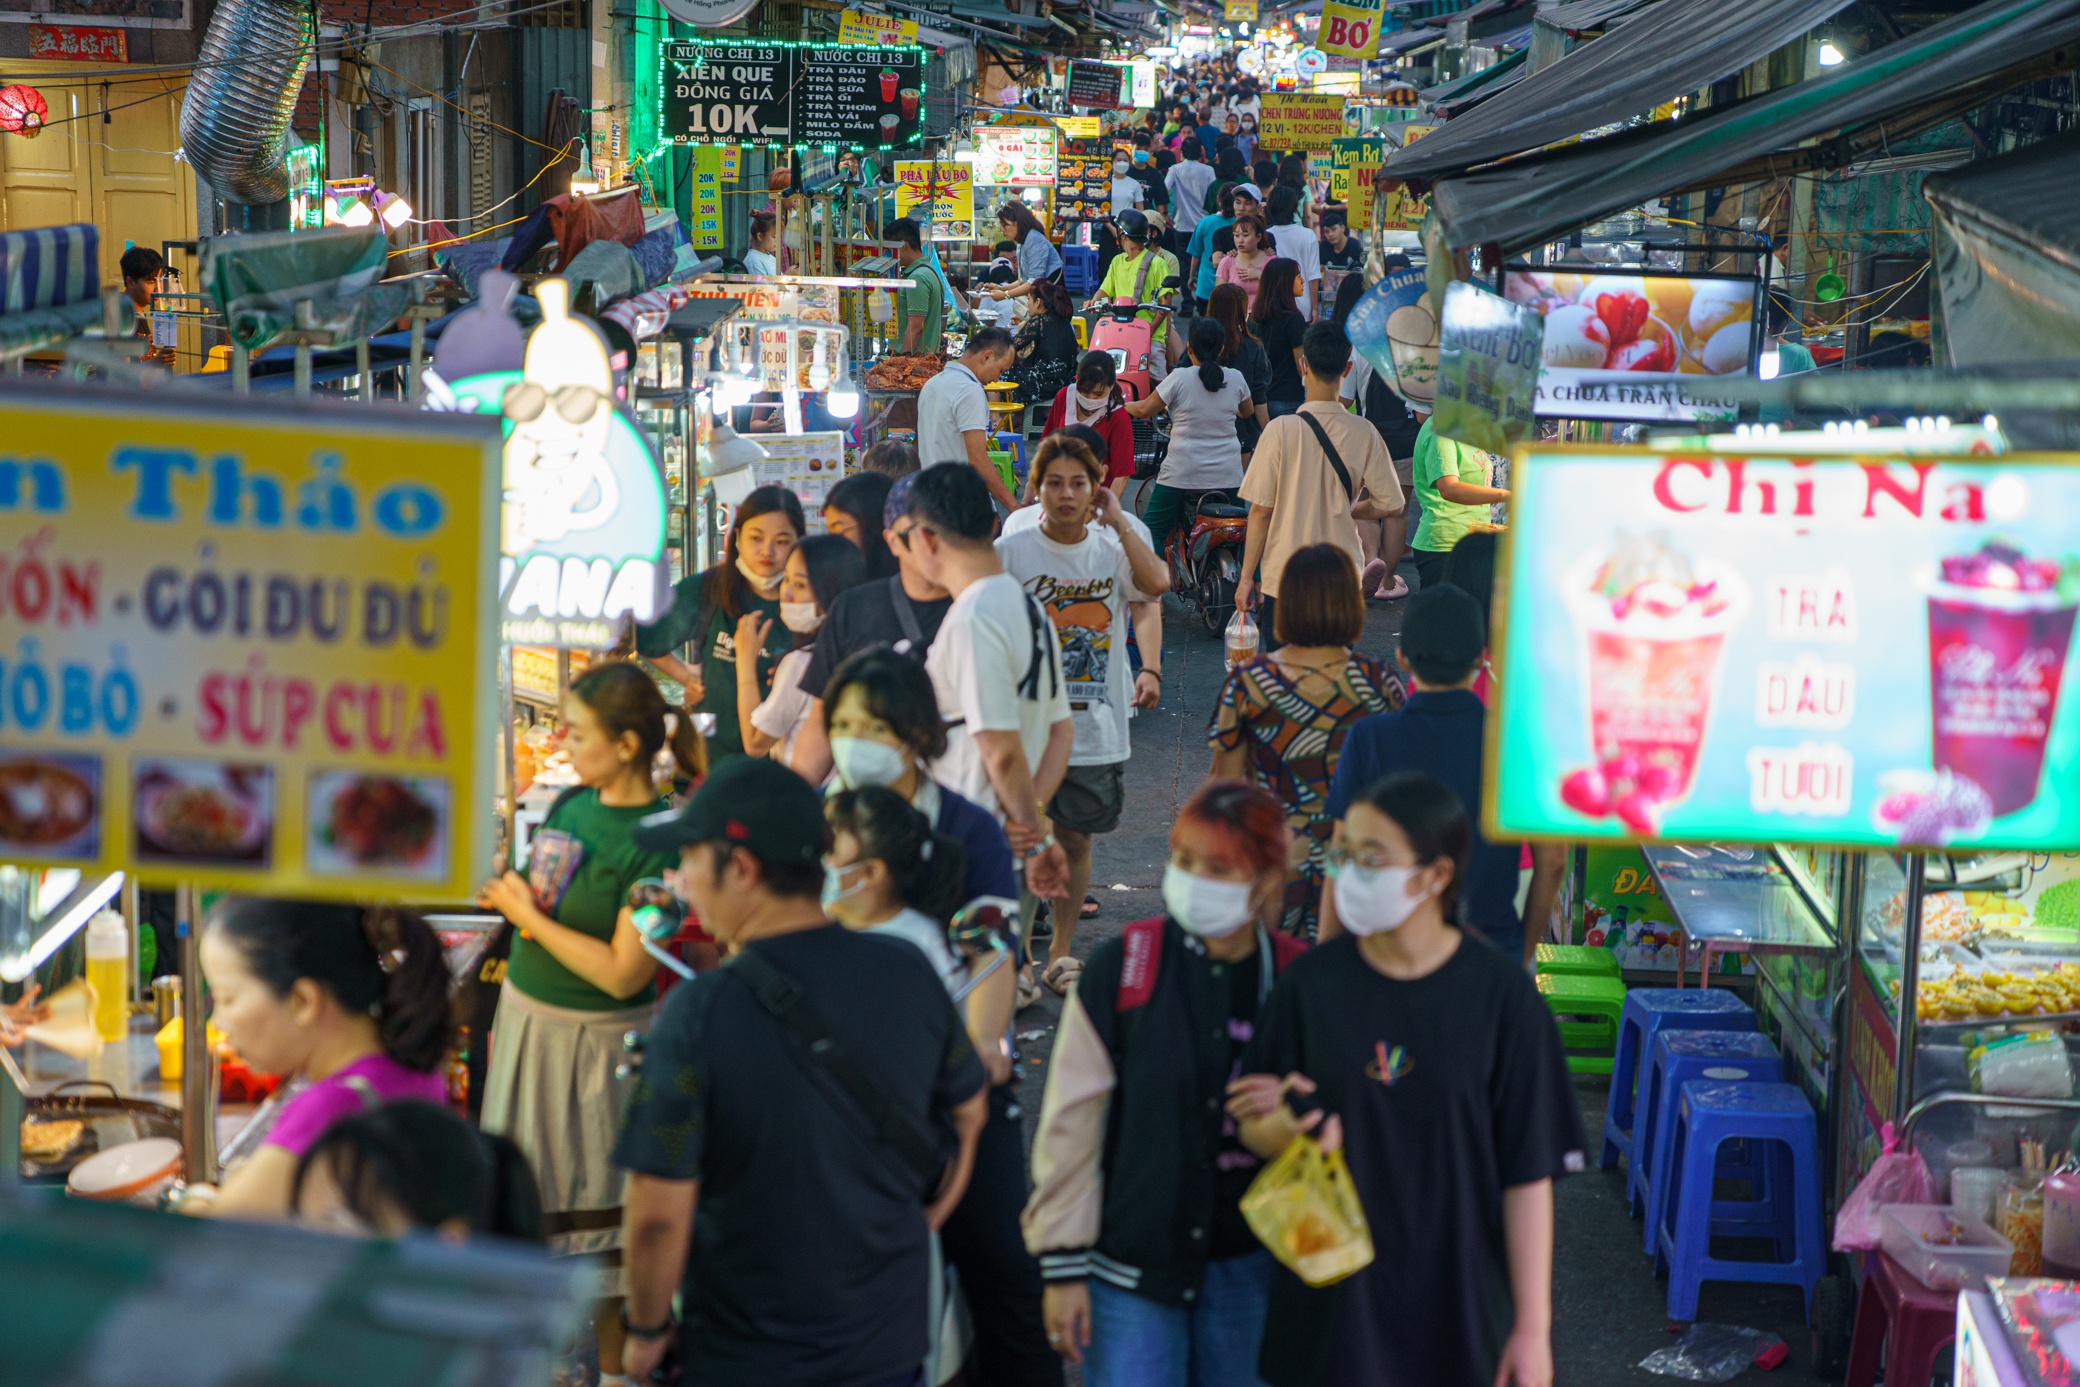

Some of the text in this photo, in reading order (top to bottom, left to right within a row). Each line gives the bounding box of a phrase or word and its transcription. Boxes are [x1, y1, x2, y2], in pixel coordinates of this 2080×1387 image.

[854, 15, 902, 31] JULIE
[1326, 15, 1373, 49] BƠ
[676, 45, 774, 62] NƯỚNG CHỊ 13
[814, 49, 903, 65] NƯỚC CHỊ 13
[732, 66, 774, 83] QUE
[808, 66, 834, 74] TRÀ
[807, 75, 834, 83] TRÀ
[675, 82, 774, 100] ĐỒNG GIÁ
[807, 84, 834, 92] TRÀ
[1298, 94, 1328, 104] Moon
[807, 102, 876, 111] TRÀ THƠM
[688, 103, 759, 134] 10K
[807, 111, 834, 119] TRÀ
[1262, 123, 1272, 133] 12
[1275, 123, 1284, 136] VỊ
[675, 134, 687, 142] CÓ
[724, 149, 736, 157] 20K
[1333, 144, 1379, 165] Kem Bơ
[724, 160, 735, 168] 15K
[698, 173, 714, 183] 20K
[953, 166, 969, 182] BÒ
[699, 189, 715, 198] 20K
[700, 205, 716, 214] 20K
[701, 220, 717, 230] 15K
[702, 235, 718, 245] 15K
[1376, 271, 1425, 297] Chua
[108, 443, 445, 538] Thảo
[323, 680, 446, 760] CUA
